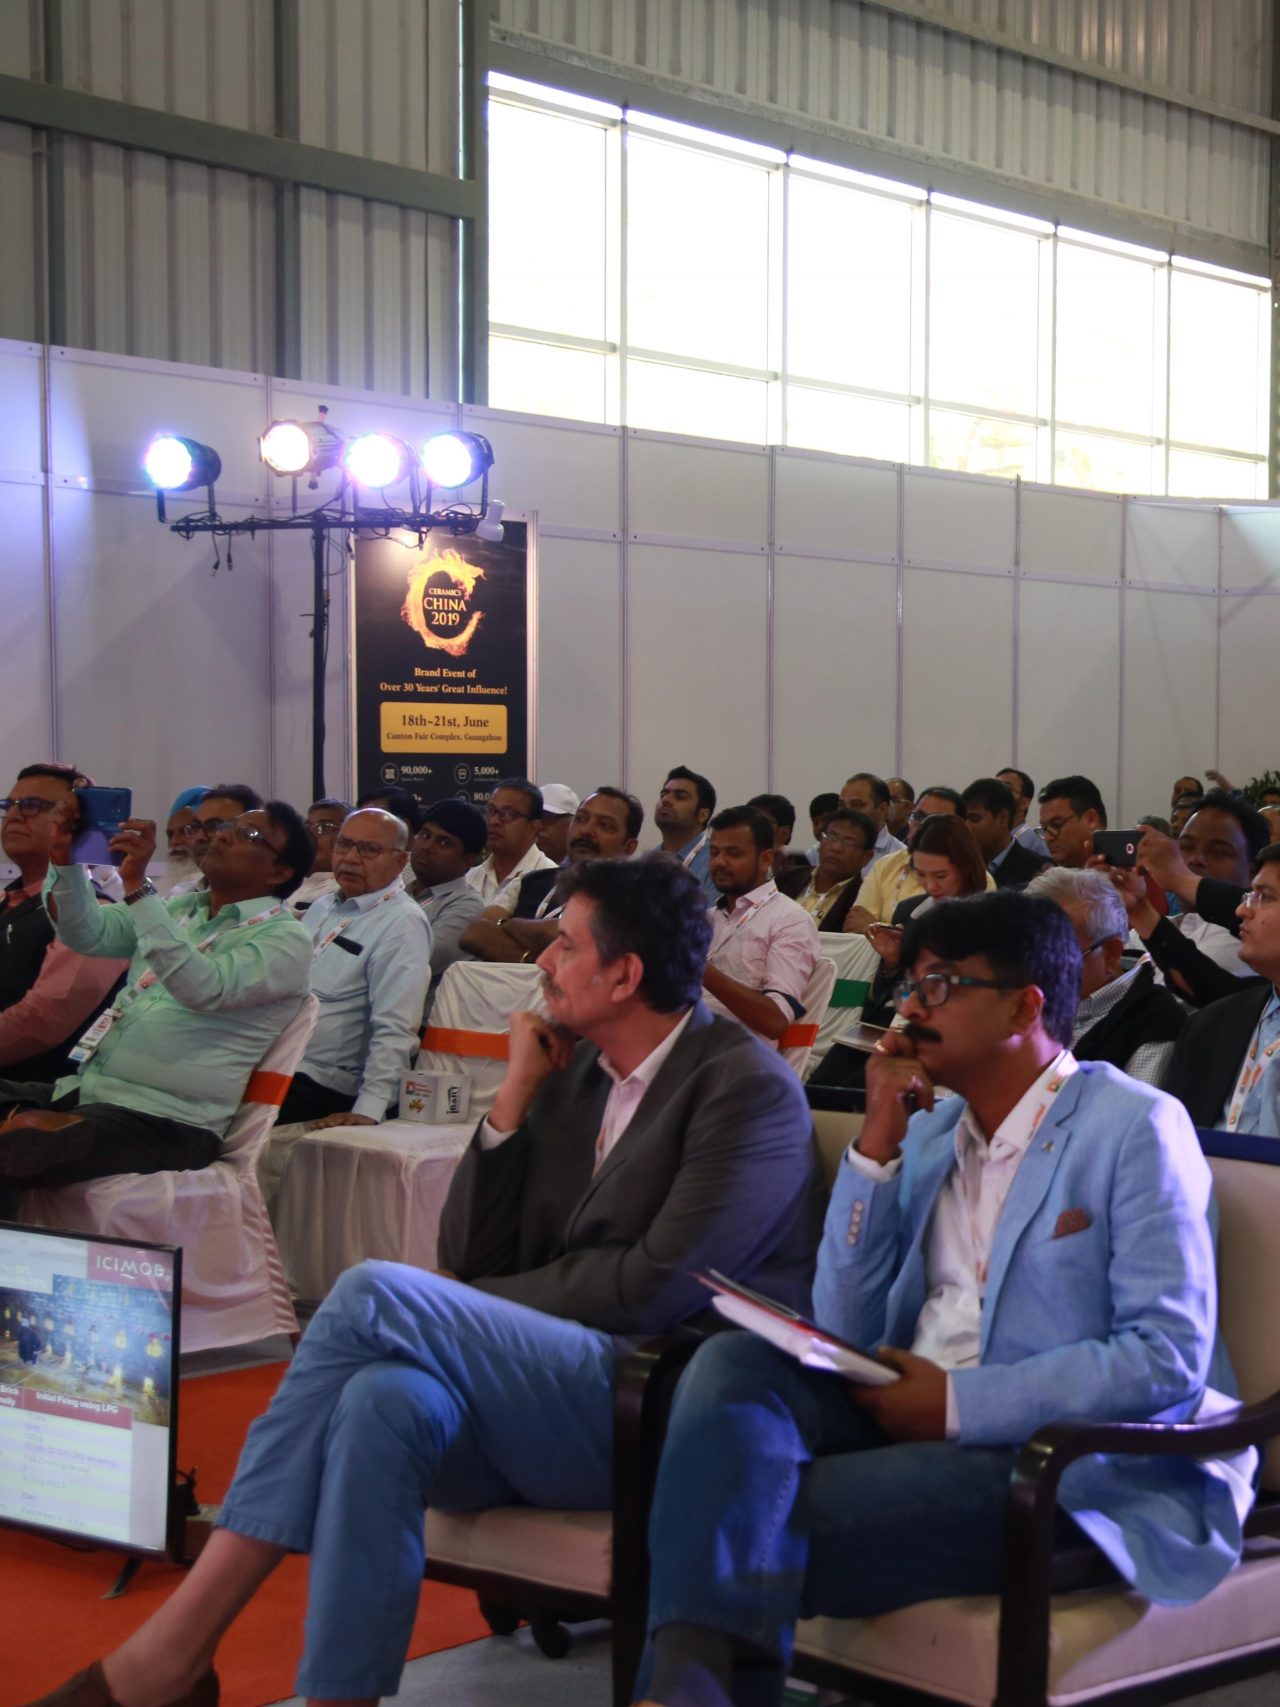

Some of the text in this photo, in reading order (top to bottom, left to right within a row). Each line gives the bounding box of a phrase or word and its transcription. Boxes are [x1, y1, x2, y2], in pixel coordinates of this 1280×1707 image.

[428, 588, 462, 596] CERAMICS
[424, 597, 467, 612] CHINA
[432, 612, 460, 625] 2019
[414, 667, 477, 678] Brand Event of
[379, 682, 401, 692] Over
[403, 683, 414, 692] 30
[442, 684, 465, 693] Great
[467, 685, 508, 695] Influence!
[402, 715, 489, 728] 18th~21st, June
[387, 732, 502, 743] Canton Fair Complex, Guangzhou
[401, 766, 432, 776] 90,000+
[474, 767, 499, 776] 5,000+
[58, 1395, 79, 1407] Firing
[80, 1400, 100, 1412] using
[102, 1404, 119, 1413] LPG
